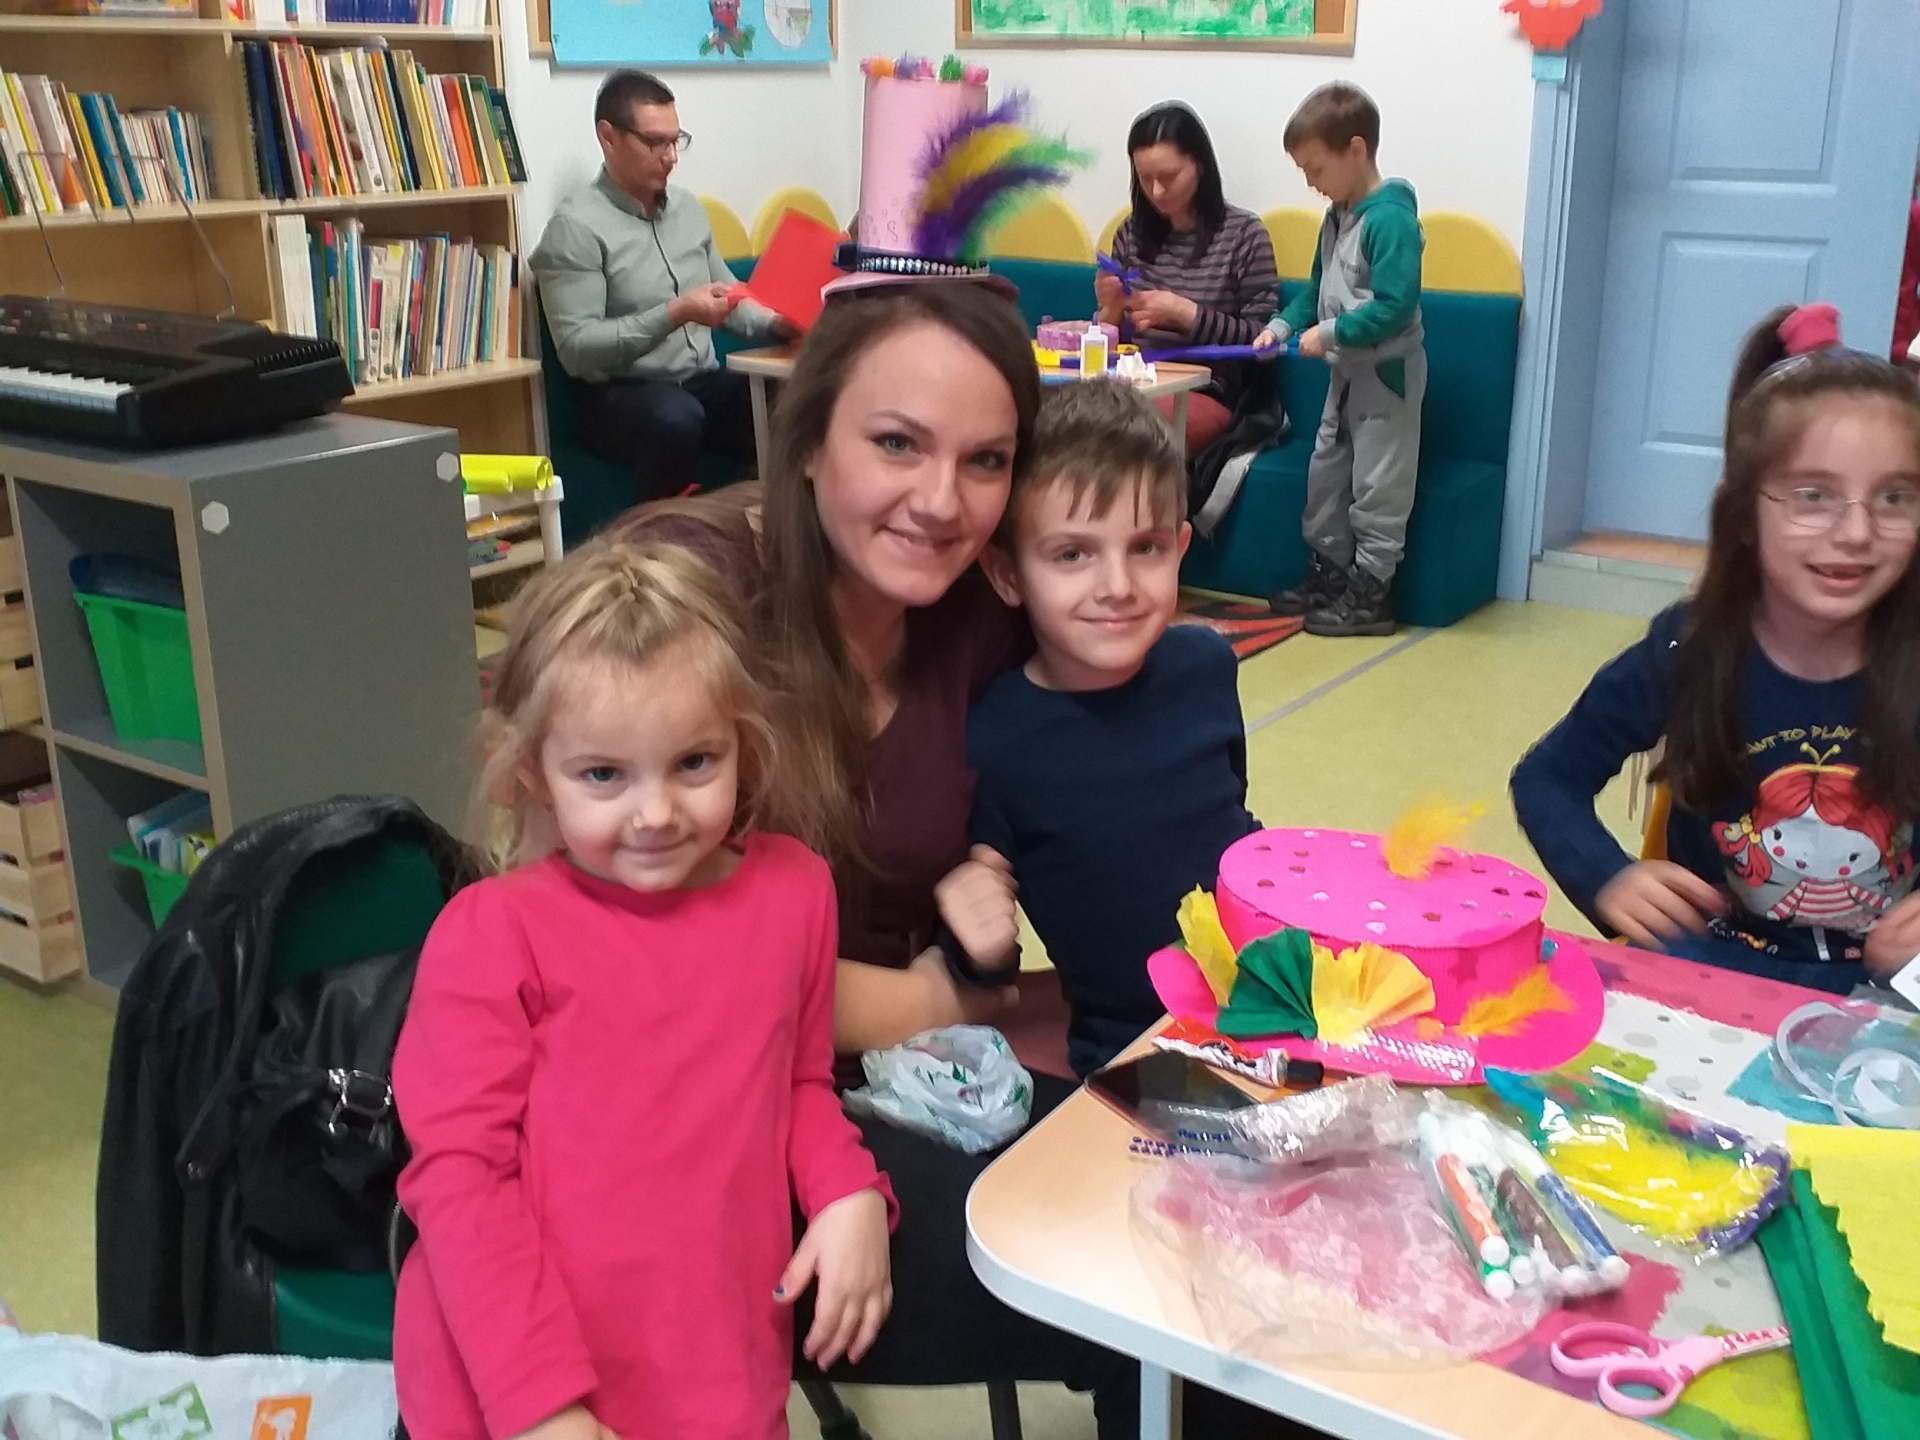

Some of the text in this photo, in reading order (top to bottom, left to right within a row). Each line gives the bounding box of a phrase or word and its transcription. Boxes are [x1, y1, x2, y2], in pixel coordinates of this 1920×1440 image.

[1746, 725, 1857, 754] ANT TO PLAY
